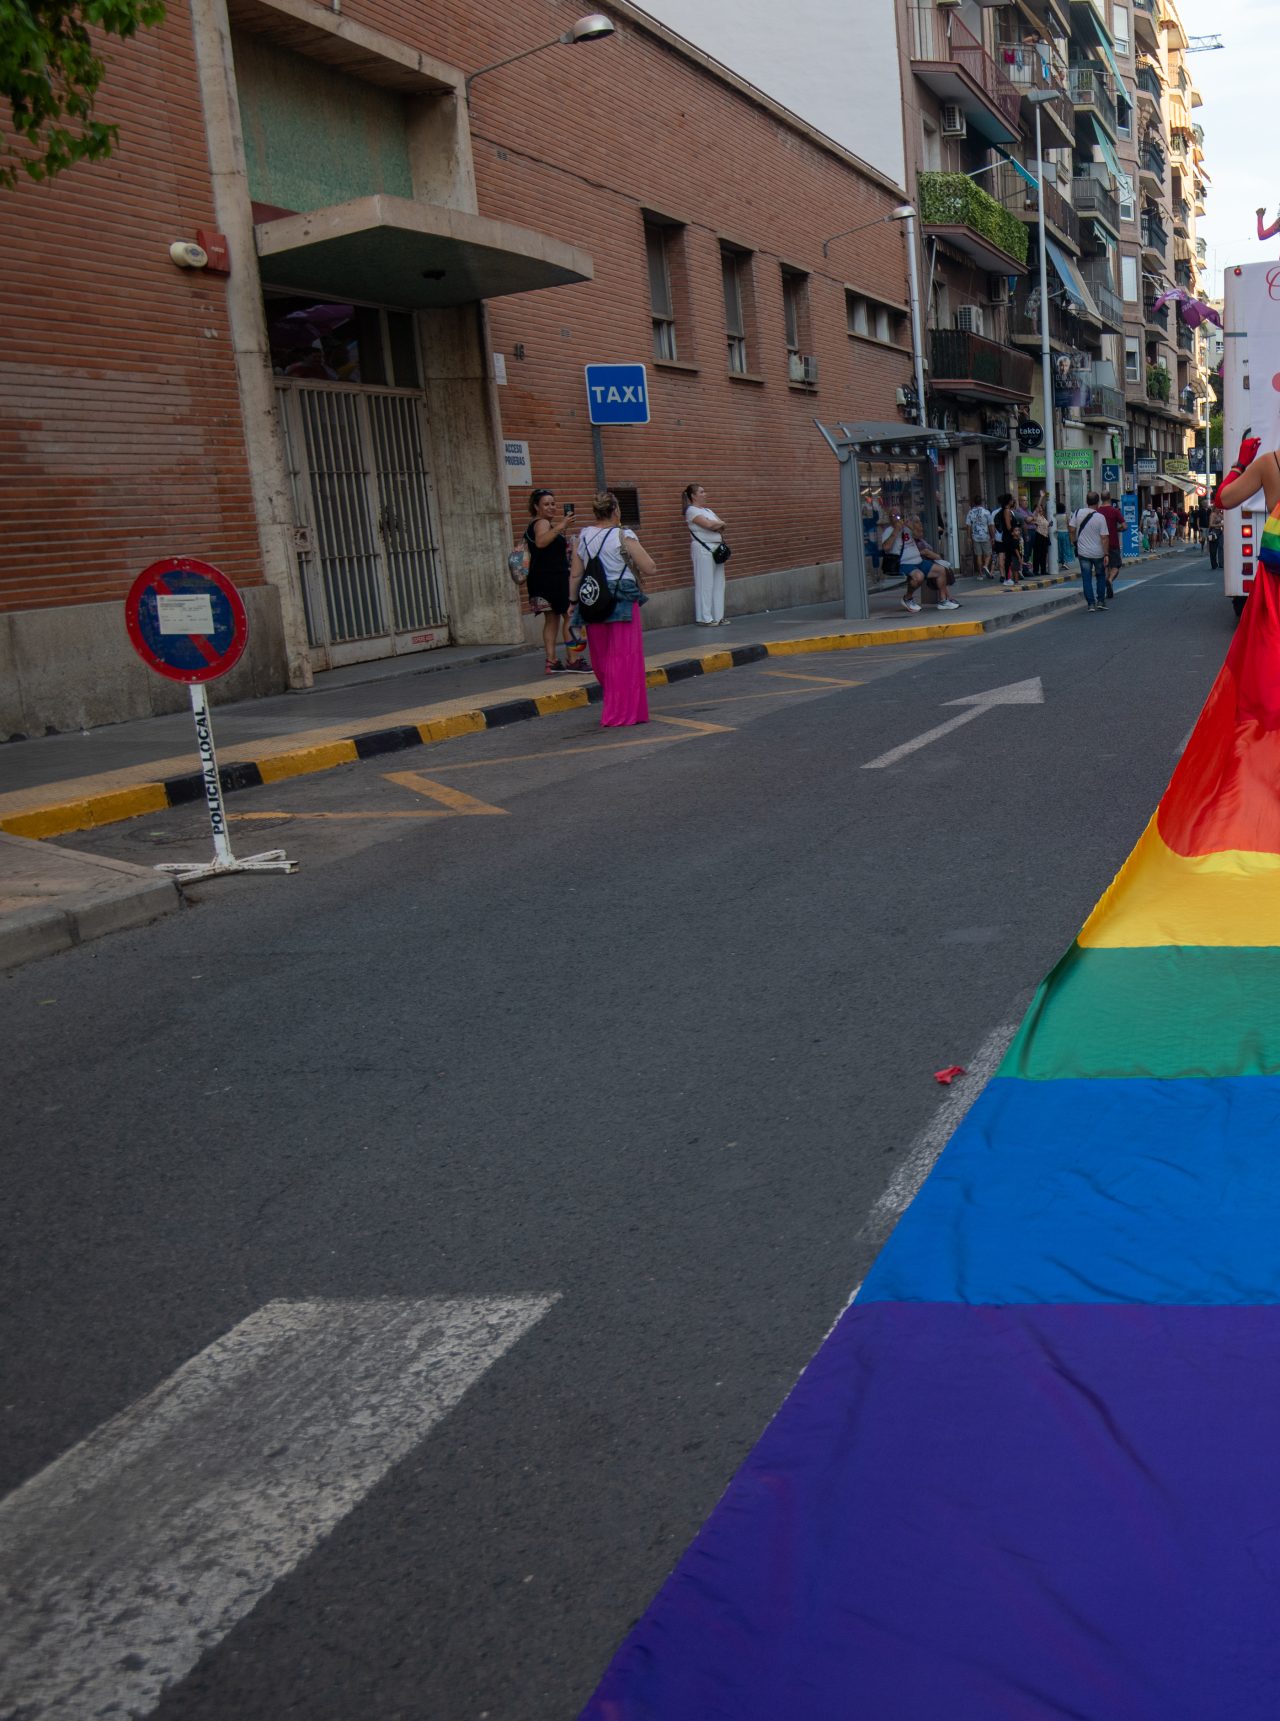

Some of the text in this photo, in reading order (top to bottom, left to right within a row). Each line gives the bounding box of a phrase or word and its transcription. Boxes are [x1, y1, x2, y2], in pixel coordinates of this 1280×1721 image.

[592, 385, 644, 404] TAXI
[1019, 427, 1041, 435] takto
[505, 443, 523, 454] ACCESO
[504, 455, 526, 466] PRUEBAS
[1131, 524, 1139, 548] TAXI
[195, 706, 225, 835] POLICIA LOCAL
